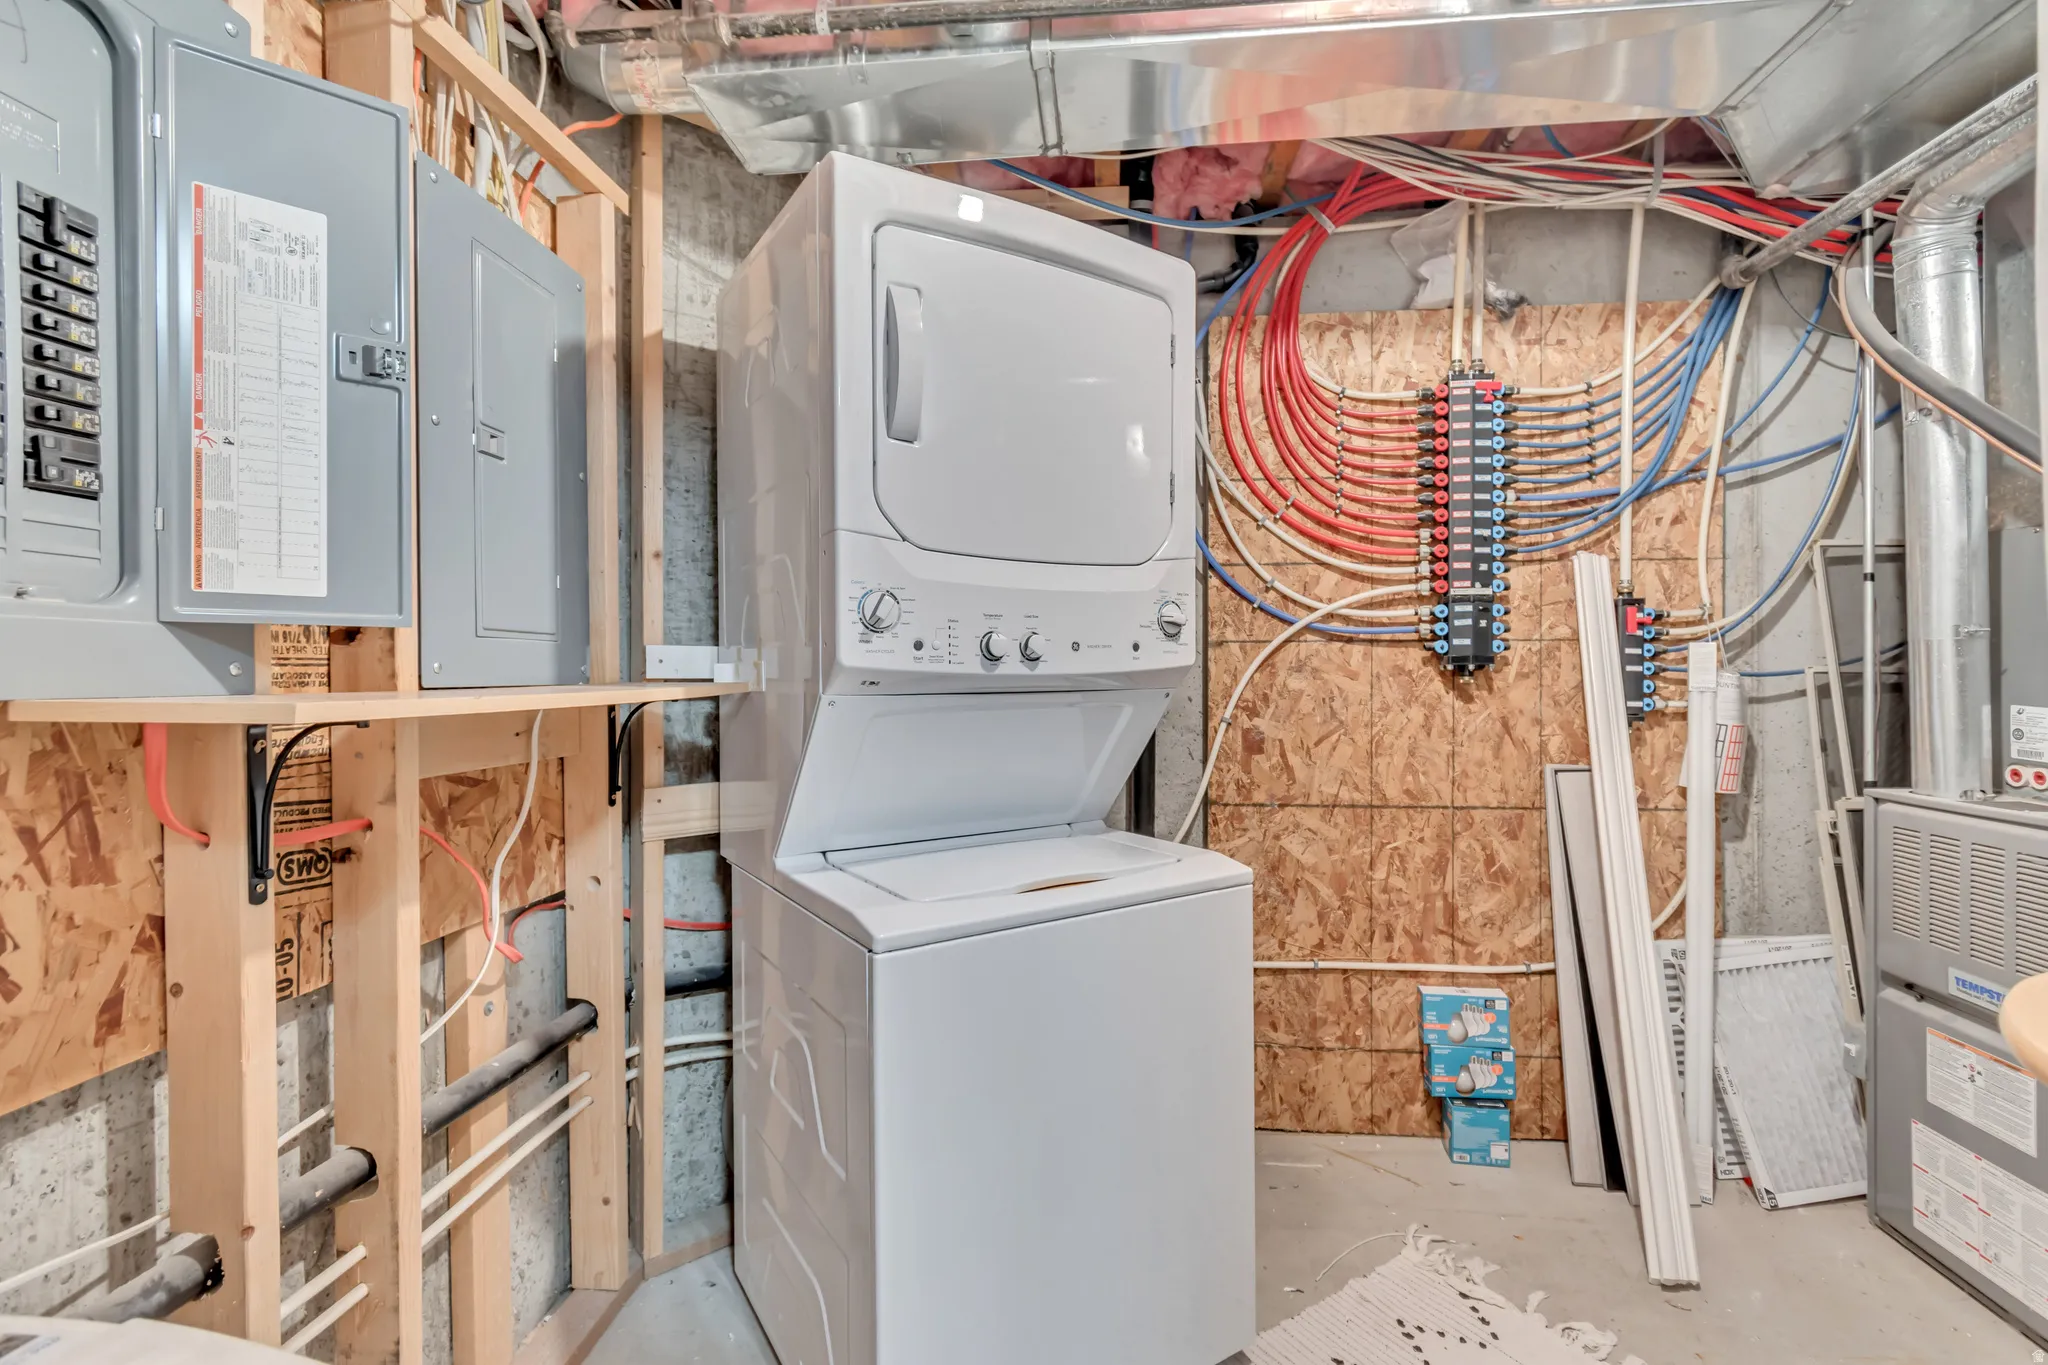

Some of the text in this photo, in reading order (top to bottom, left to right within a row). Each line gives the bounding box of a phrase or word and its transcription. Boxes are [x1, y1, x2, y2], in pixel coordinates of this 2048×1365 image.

[195, 208, 203, 235] DANGER
[195, 290, 203, 317] PELIGRO
[195, 373, 203, 399] DANGER
[195, 451, 203, 500] AVERTISSEMENT
[195, 508, 203, 549] ADVERTENCIA
[195, 554, 203, 582] WARNING
[284, 854, 328, 879] QMS
[1954, 976, 2005, 1003] TEMPST
